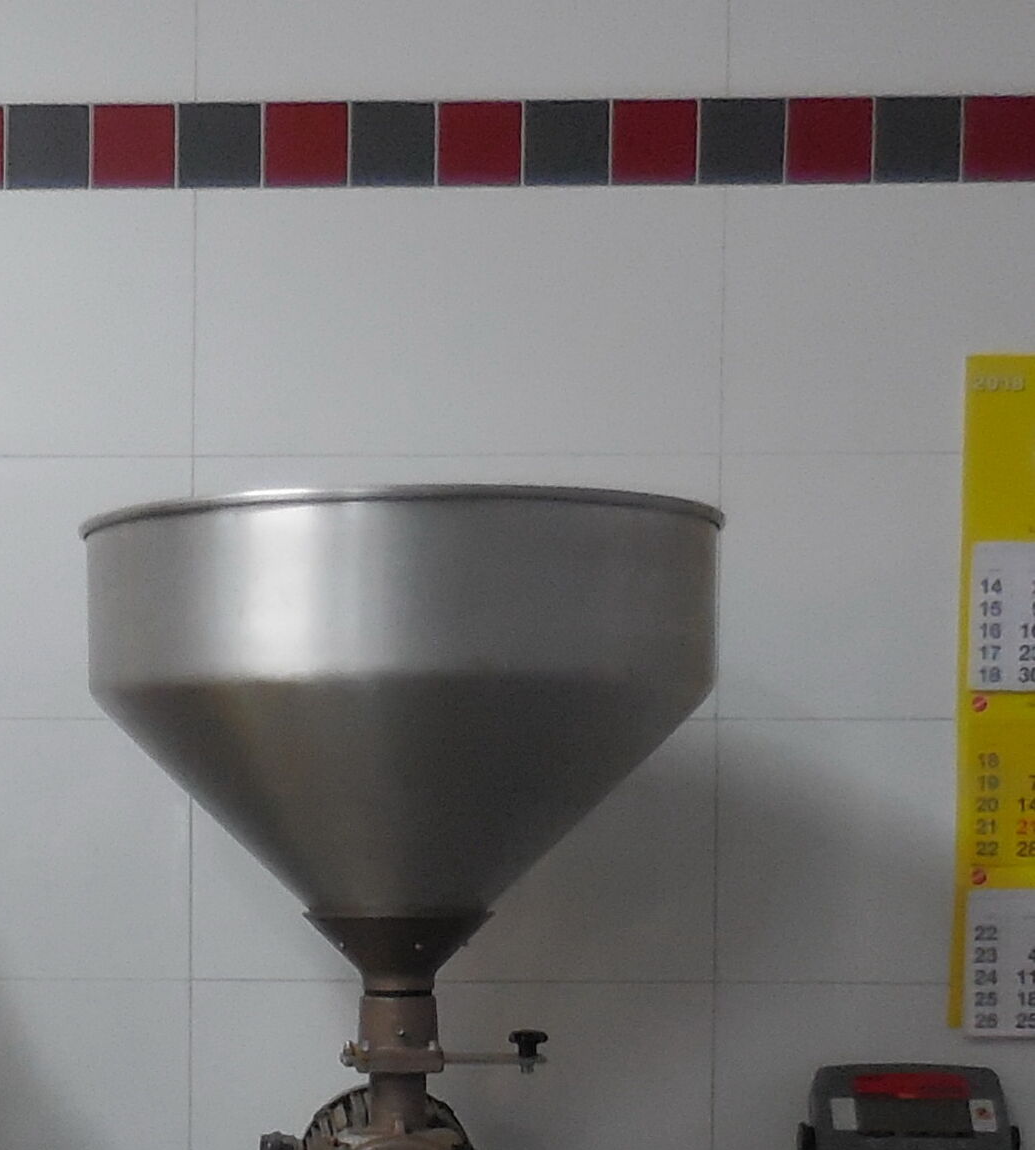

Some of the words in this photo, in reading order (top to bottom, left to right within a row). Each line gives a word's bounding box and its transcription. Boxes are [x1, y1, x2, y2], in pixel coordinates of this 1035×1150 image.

[980, 578, 1002, 594] 14
[980, 600, 1002, 616] 15
[980, 645, 1001, 660] 17
[974, 924, 998, 941] 22
[974, 969, 997, 985] 24
